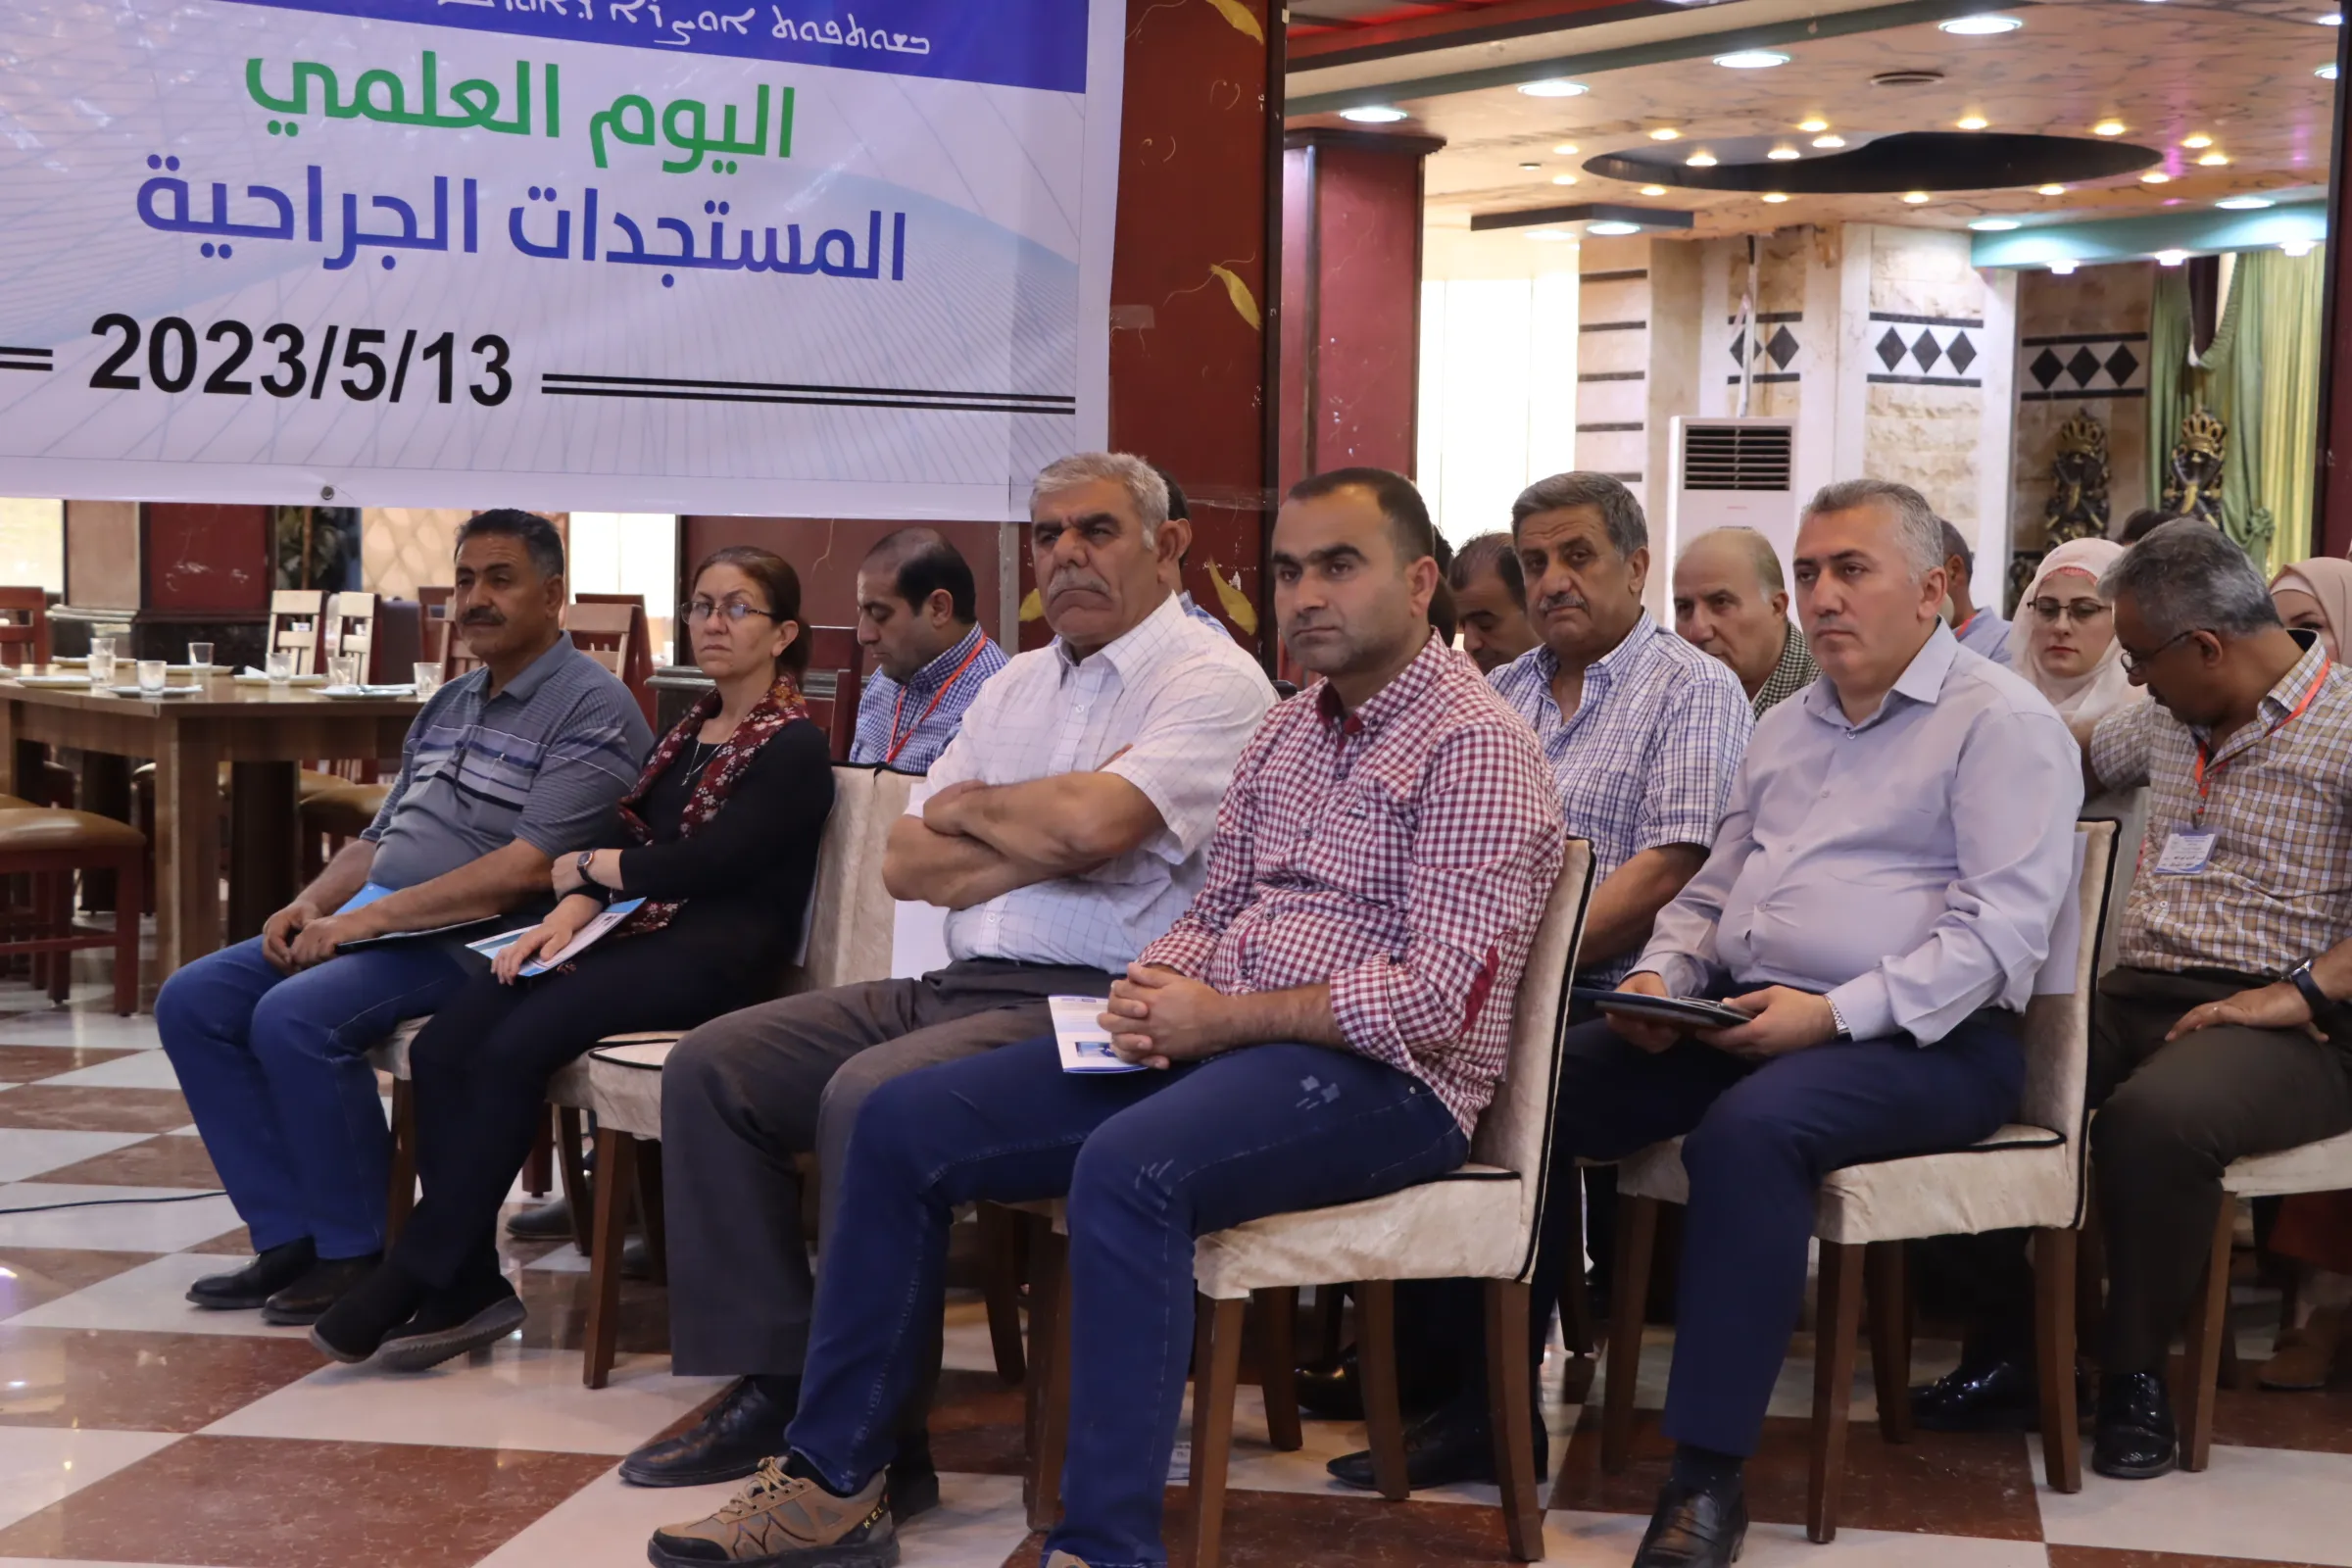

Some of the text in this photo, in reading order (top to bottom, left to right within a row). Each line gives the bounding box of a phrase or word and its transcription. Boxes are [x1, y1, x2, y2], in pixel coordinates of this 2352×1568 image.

[246, 51, 795, 174] اليوم العلمي
[137, 155, 906, 287] المستجدات الجراحية
[89, 313, 513, 407] 2023/5/13
